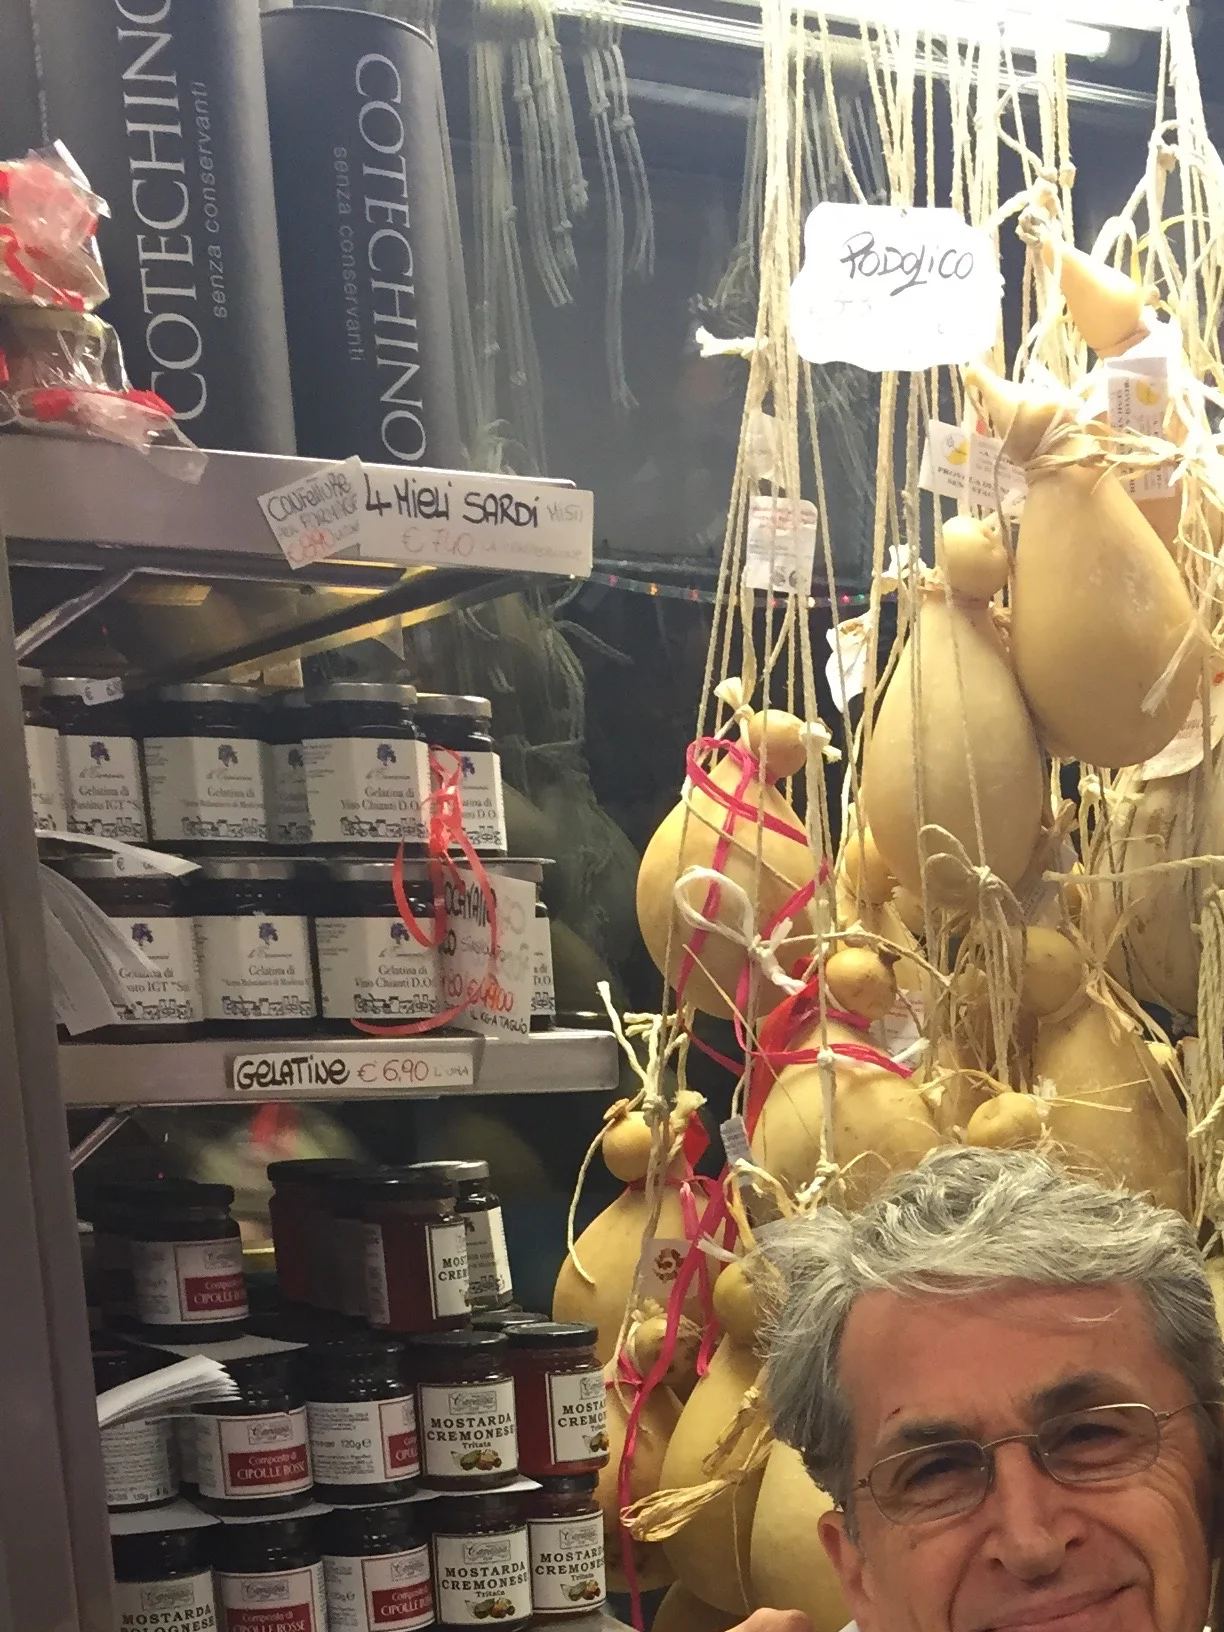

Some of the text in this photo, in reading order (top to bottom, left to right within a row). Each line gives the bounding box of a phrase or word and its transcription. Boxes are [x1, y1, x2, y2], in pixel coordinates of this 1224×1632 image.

[189, 81, 228, 319] senza conservanti
[333, 146, 364, 361] senza conservanti
[355, 52, 427, 462] COTECHINO
[364, 472, 392, 517] 4
[378, 963, 428, 976] Gelatina di
[430, 1412, 512, 1429] MOSTARDA
[426, 1423, 515, 1442] CREMONESE
[462, 1441, 492, 1450] Tritata
[236, 1466, 282, 1480] CIPOLLE
[445, 1561, 526, 1578] MOSTARDA
[441, 1571, 528, 1591] CREMONESE
[122, 1604, 212, 1626] MOSTARDA
[276, 1619, 306, 1632] ROSSE
